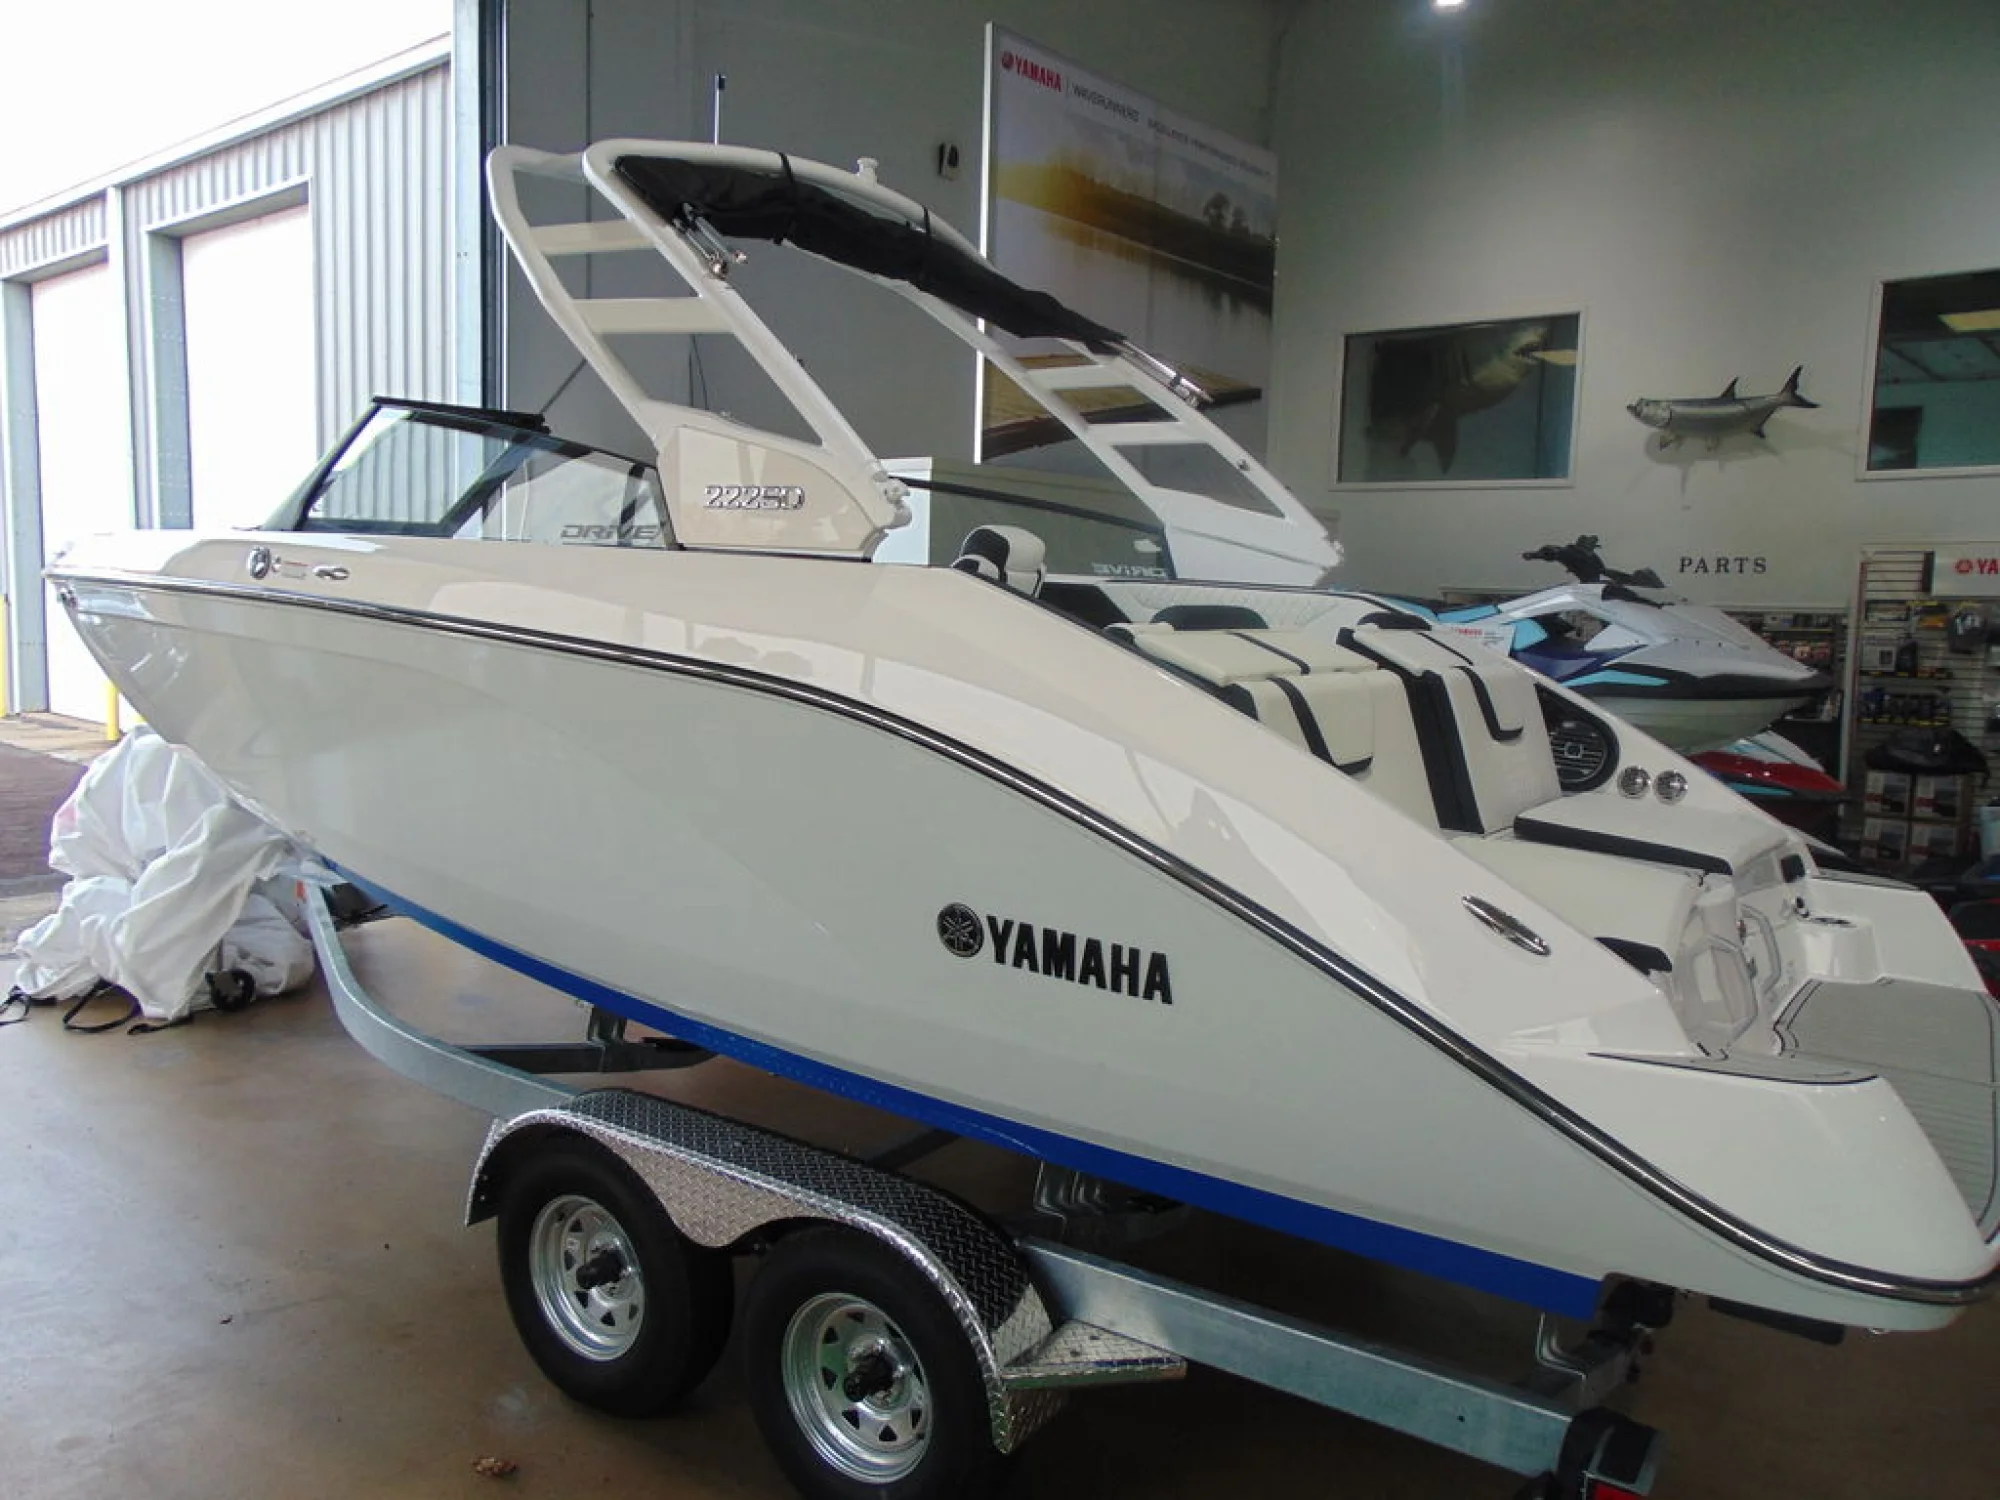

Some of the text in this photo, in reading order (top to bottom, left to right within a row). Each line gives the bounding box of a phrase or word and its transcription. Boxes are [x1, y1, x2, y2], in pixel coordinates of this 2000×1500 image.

[1015, 55, 1062, 92] YAMAHA
[703, 485, 806, 510] 222SD
[1679, 556, 1766, 574] PARTS
[986, 914, 1173, 1005] YAMAHA
